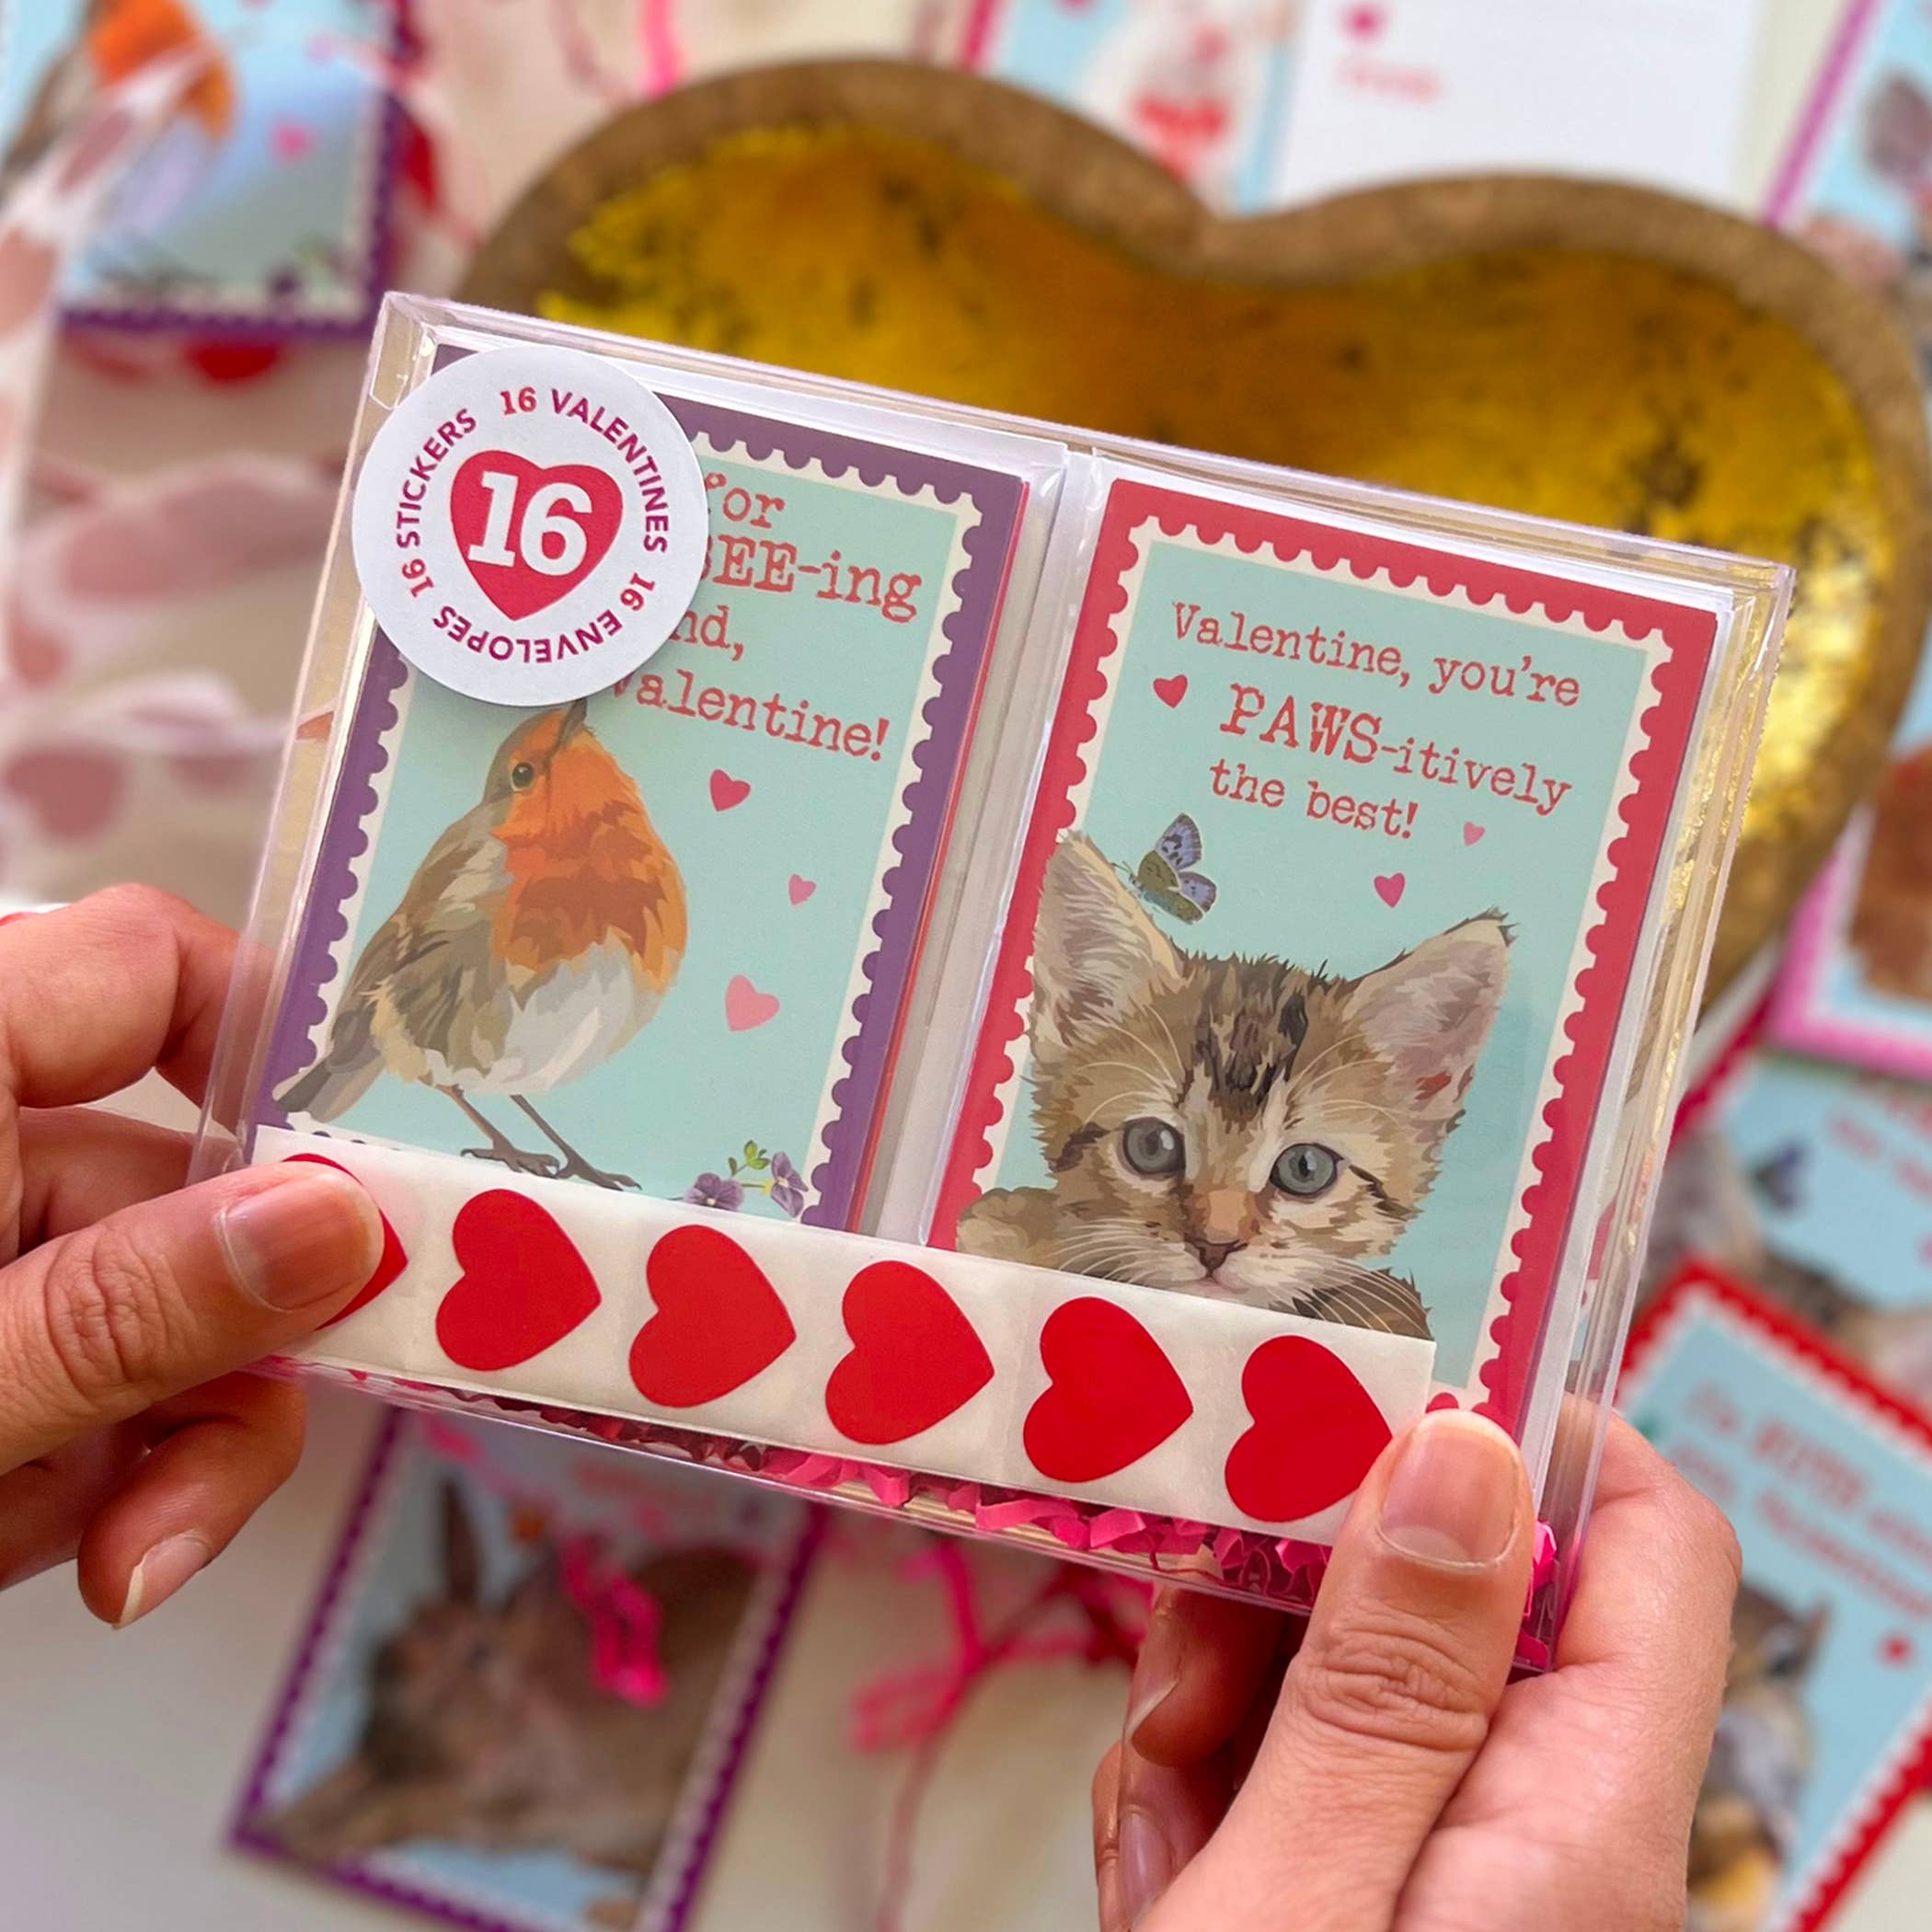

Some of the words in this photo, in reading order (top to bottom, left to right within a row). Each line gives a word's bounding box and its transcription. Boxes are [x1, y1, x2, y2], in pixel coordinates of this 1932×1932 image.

[397, 408, 477, 549] STICKERS
[500, 386, 537, 415] 16
[551, 387, 669, 553] VALENTINES
[466, 470, 593, 577] 16
[401, 558, 434, 597] 16
[619, 572, 655, 612] 16
[701, 534, 922, 625] EE-ing
[431, 604, 623, 663] ENVELOPES
[668, 604, 744, 661] nd,
[1173, 602, 1410, 687] Valentine,
[1428, 655, 1581, 707] you're
[1219, 682, 1572, 817] PAWS-itively
[1209, 758, 1285, 809] the
[1305, 780, 1419, 839] best!
